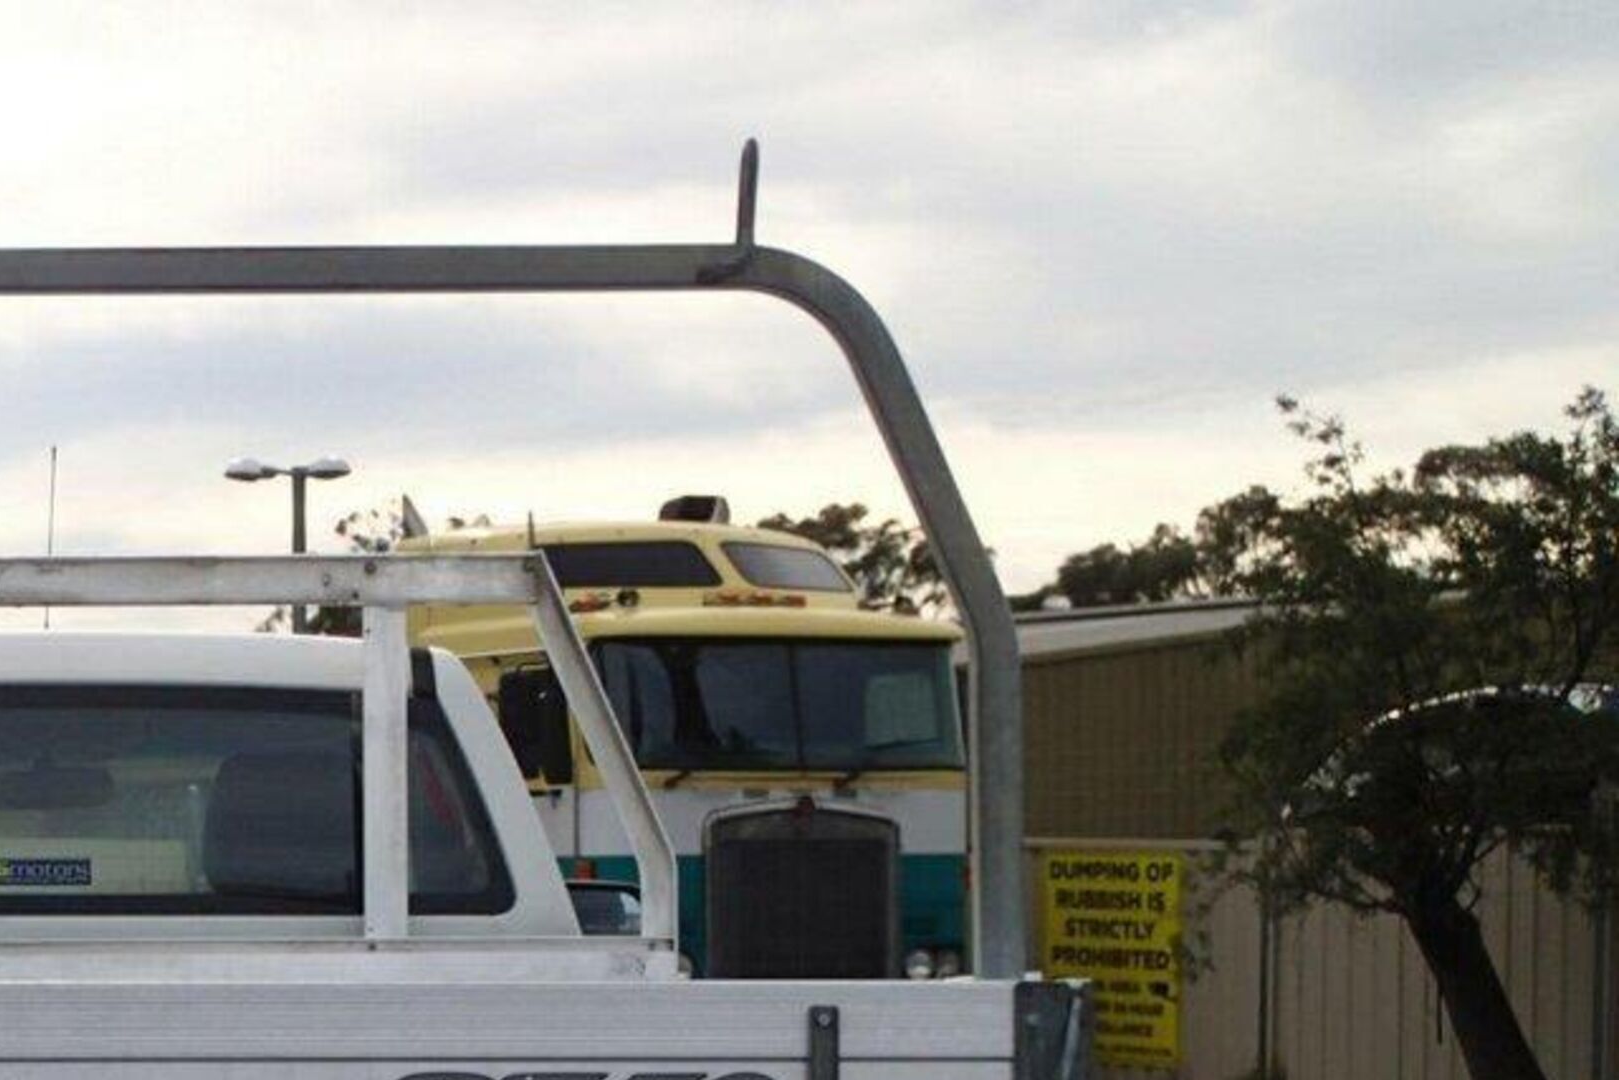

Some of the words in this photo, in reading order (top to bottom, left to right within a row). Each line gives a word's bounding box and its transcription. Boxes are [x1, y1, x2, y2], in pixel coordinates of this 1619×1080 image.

[1050, 860, 1139, 882] DUMPING
[1146, 861, 1174, 883] OF
[1055, 887, 1141, 910] RUBBISH
[1148, 891, 1165, 912] IS
[1065, 917, 1156, 940] STRICTLY
[1051, 946, 1170, 970] PROHIBITED
